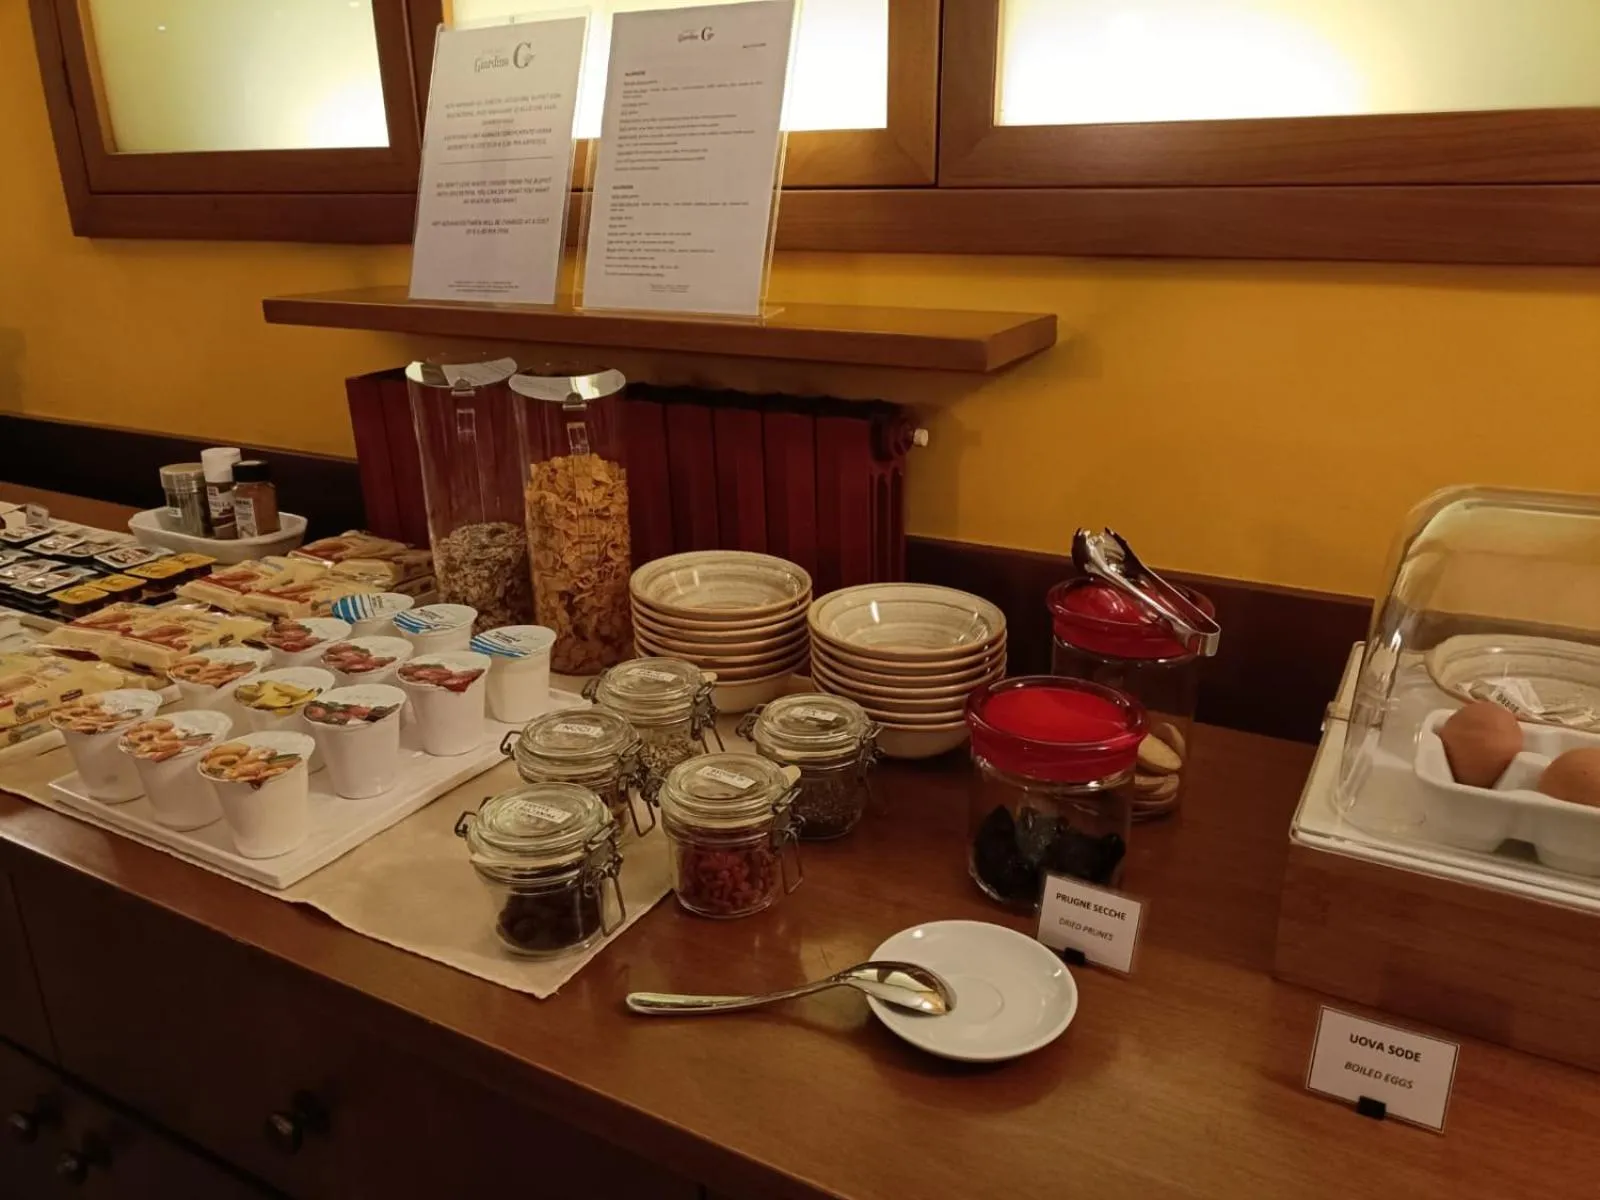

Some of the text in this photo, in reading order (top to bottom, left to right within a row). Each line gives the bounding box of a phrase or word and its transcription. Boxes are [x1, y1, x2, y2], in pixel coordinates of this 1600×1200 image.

[1056, 892, 1127, 921] PRUGNE SECCHE
[1059, 918, 1113, 940] DRIED PRUNES
[1349, 1033, 1422, 1063] UOVA SODE
[1344, 1061, 1414, 1090] BOILED EGGS
